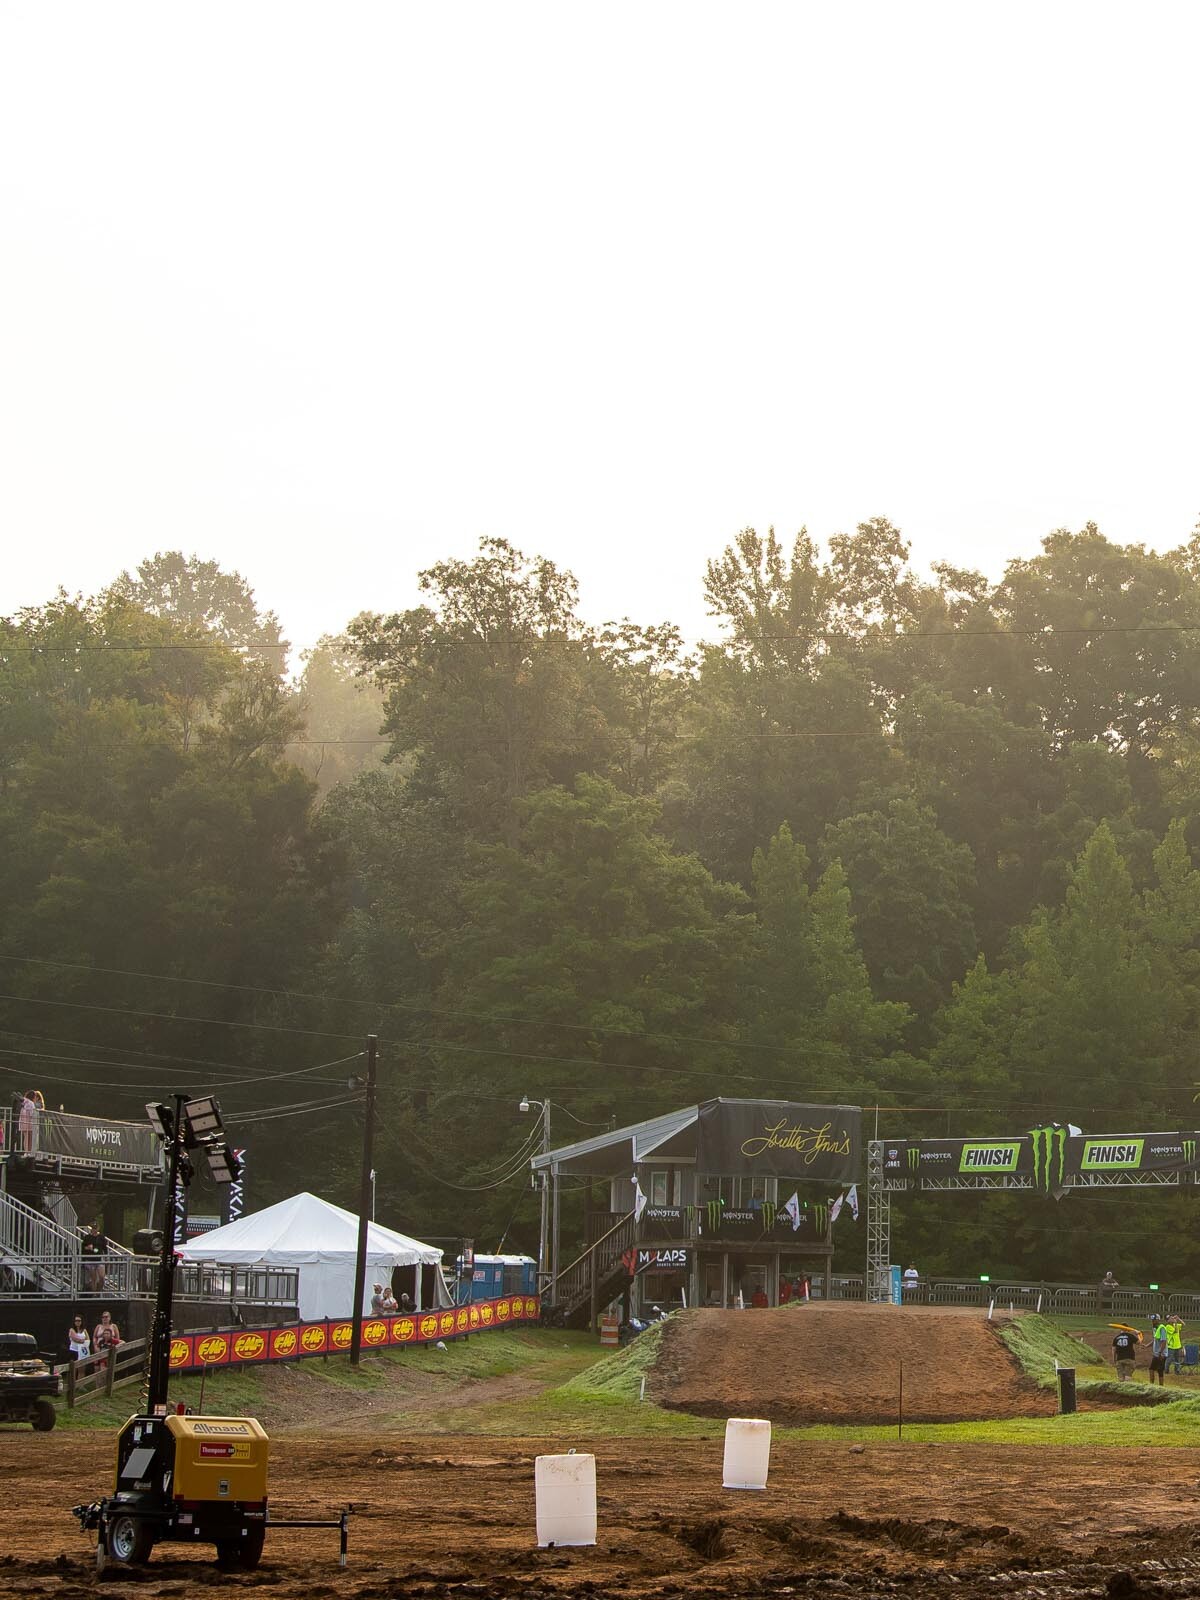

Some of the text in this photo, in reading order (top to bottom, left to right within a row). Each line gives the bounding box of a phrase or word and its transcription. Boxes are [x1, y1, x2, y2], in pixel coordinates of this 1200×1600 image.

[86, 1127, 121, 1146] MONSTER
[965, 1149, 1014, 1166] FINISH
[1087, 1146, 1137, 1163] FINISH
[647, 1209, 680, 1217] MONSTER
[723, 1212, 754, 1220] MONSTER
[332, 1326, 352, 1341] FM
[364, 1323, 387, 1338] FMF
[393, 1320, 414, 1335] FMF
[235, 1336, 264, 1351] FMF
[274, 1333, 296, 1348] FMF
[302, 1329, 324, 1344] FMF
[169, 1343, 189, 1358] MF
[199, 1340, 226, 1355] FMF
[193, 1423, 248, 1434] Allmand
[202, 1446, 226, 1454] Thompson
